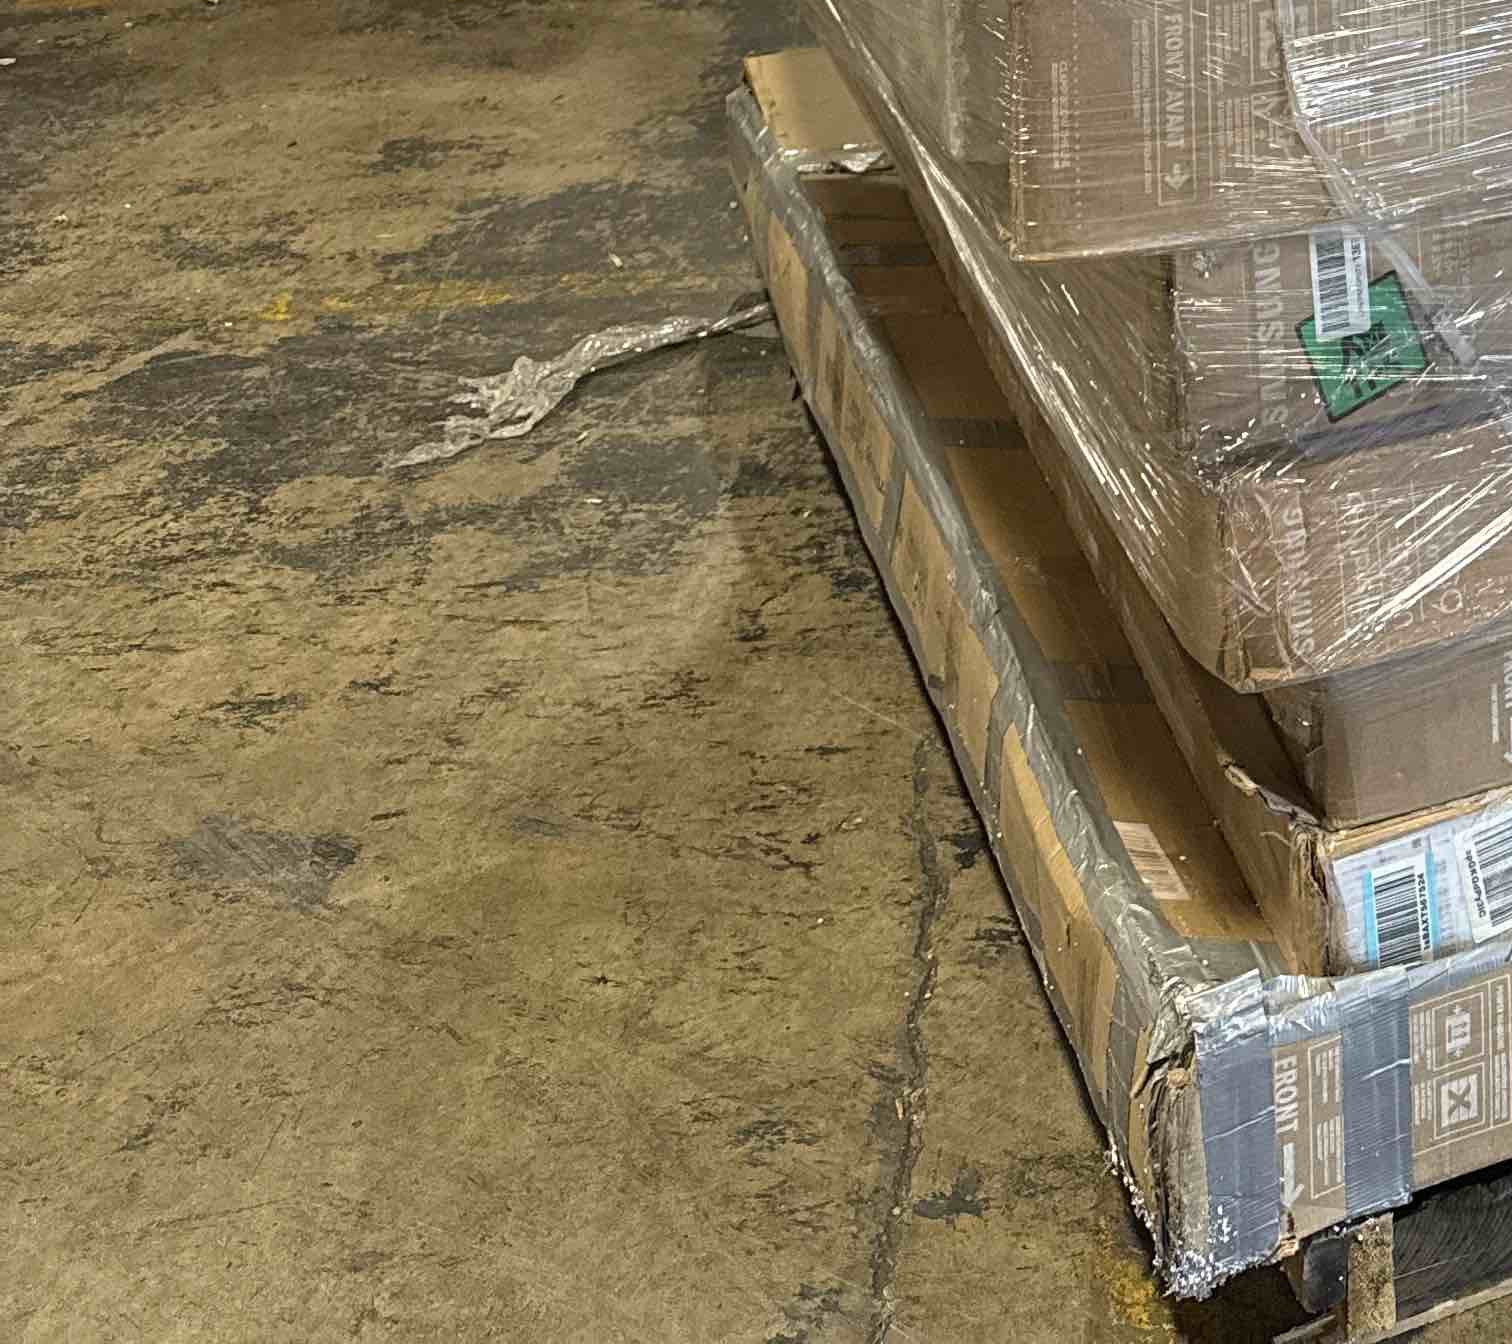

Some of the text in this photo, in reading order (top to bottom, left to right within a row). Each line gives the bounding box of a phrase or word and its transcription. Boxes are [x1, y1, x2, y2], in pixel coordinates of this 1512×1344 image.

[1163, 12, 1186, 146] FRONT/AVANT
[1253, 241, 1289, 425] SAMSUNG
[1274, 1055, 1298, 1132] FRONT
